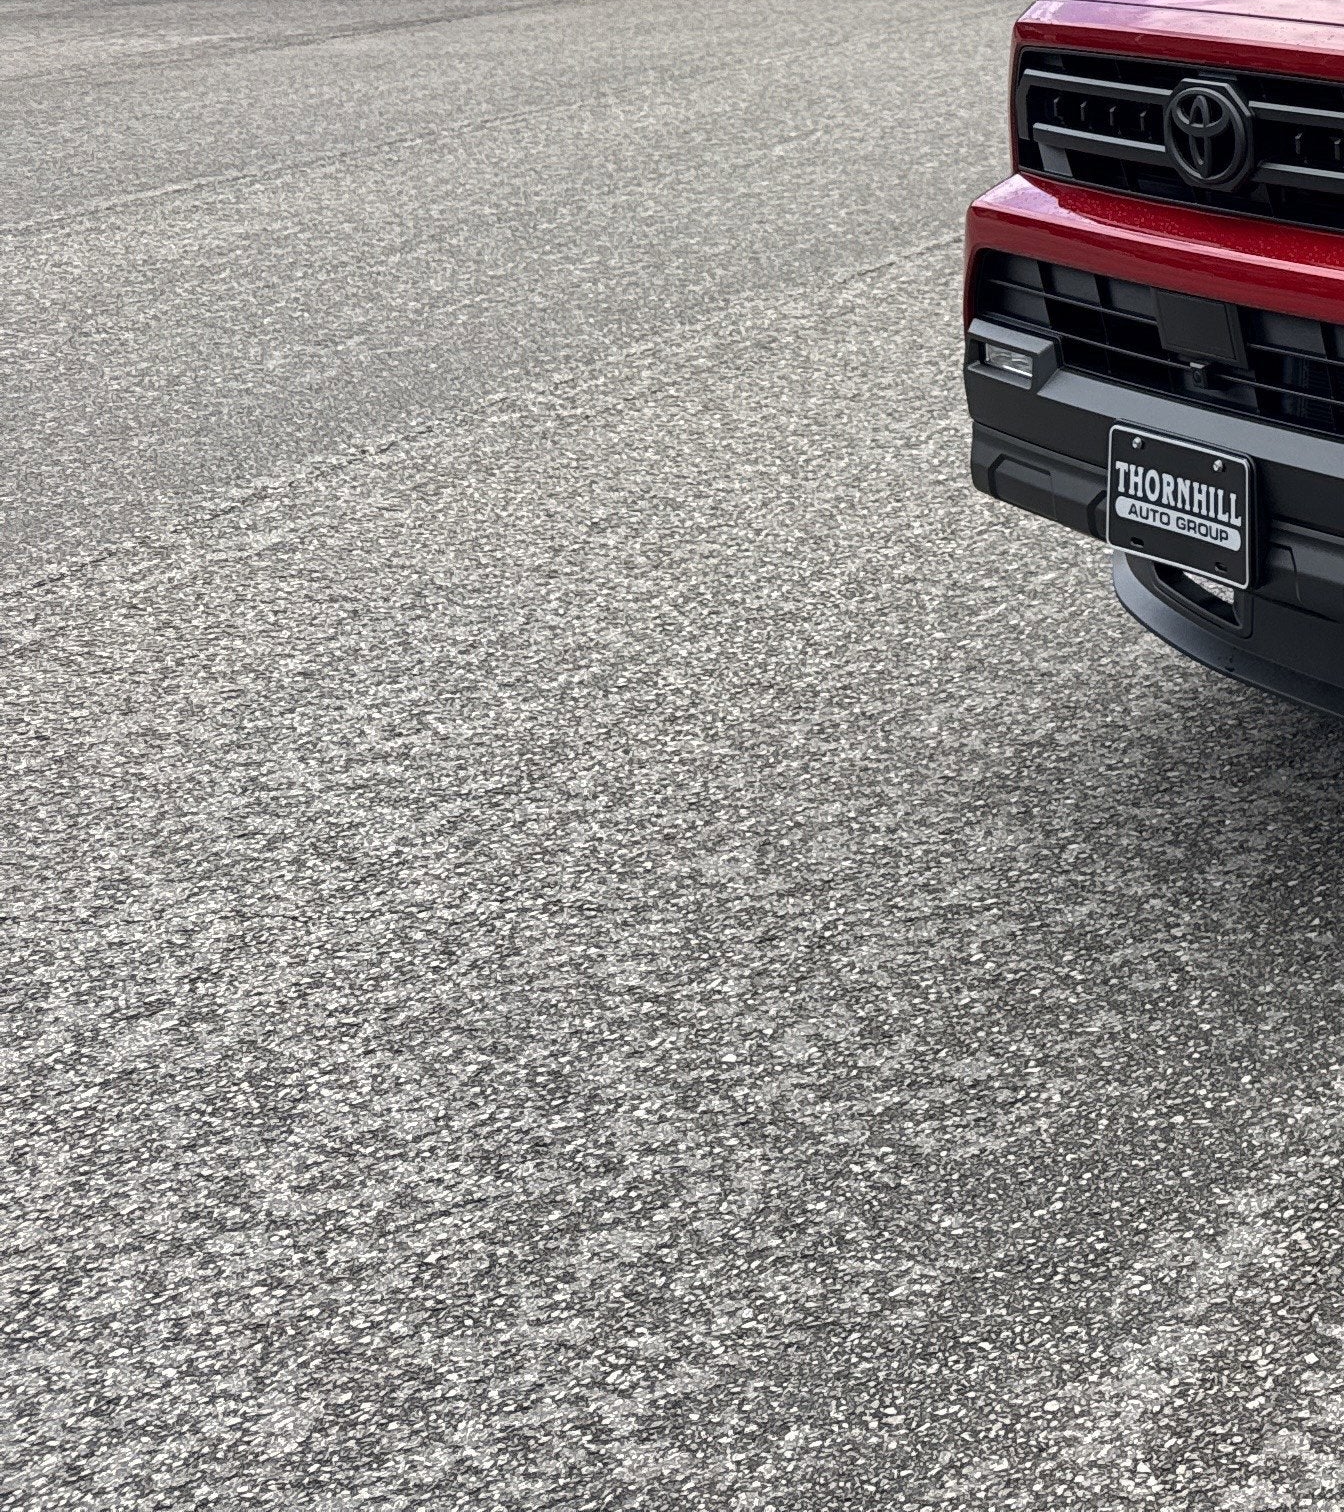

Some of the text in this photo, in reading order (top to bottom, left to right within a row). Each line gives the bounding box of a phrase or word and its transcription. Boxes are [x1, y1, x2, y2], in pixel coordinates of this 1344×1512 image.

[1115, 460, 1242, 527] THORNHILL
[1127, 502, 1229, 543] AUTO GROUP
